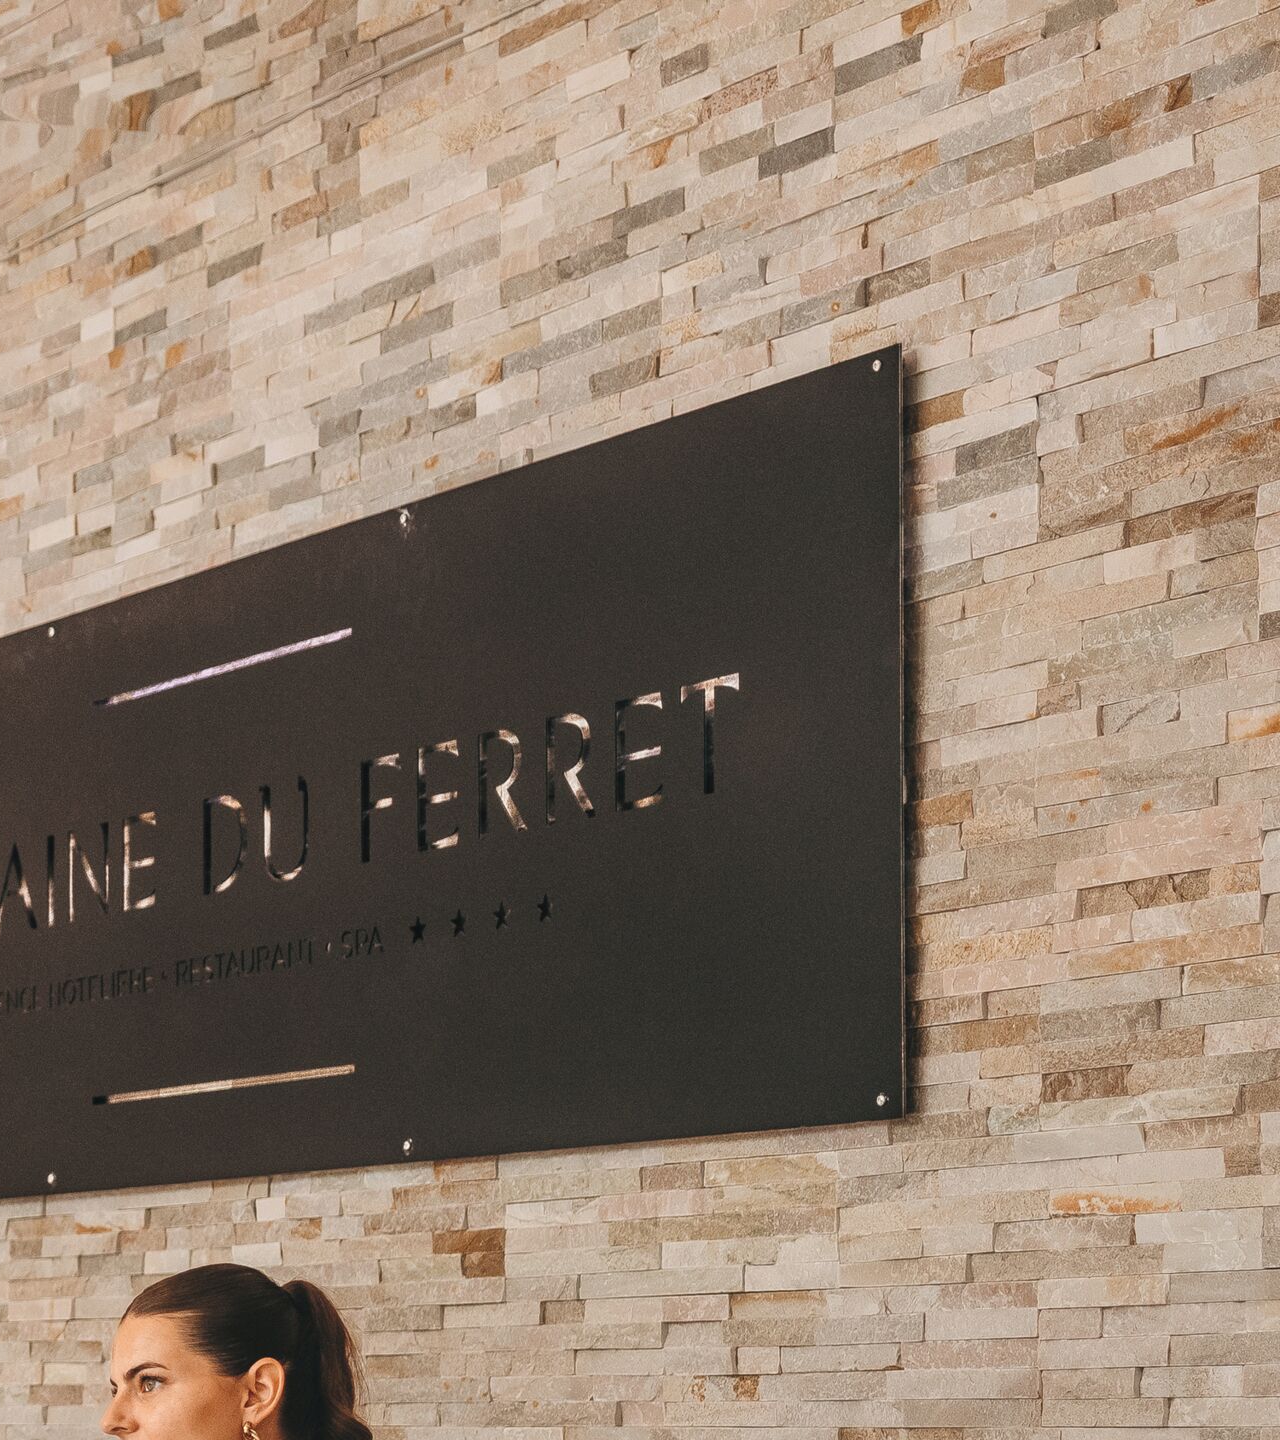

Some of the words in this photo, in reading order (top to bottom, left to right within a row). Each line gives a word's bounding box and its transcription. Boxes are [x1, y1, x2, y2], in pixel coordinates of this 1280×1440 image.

[203, 775, 309, 895] DU
[360, 671, 740, 864] FERRET
[174, 937, 317, 987] RESTAURANT
[340, 925, 385, 960] SPA
